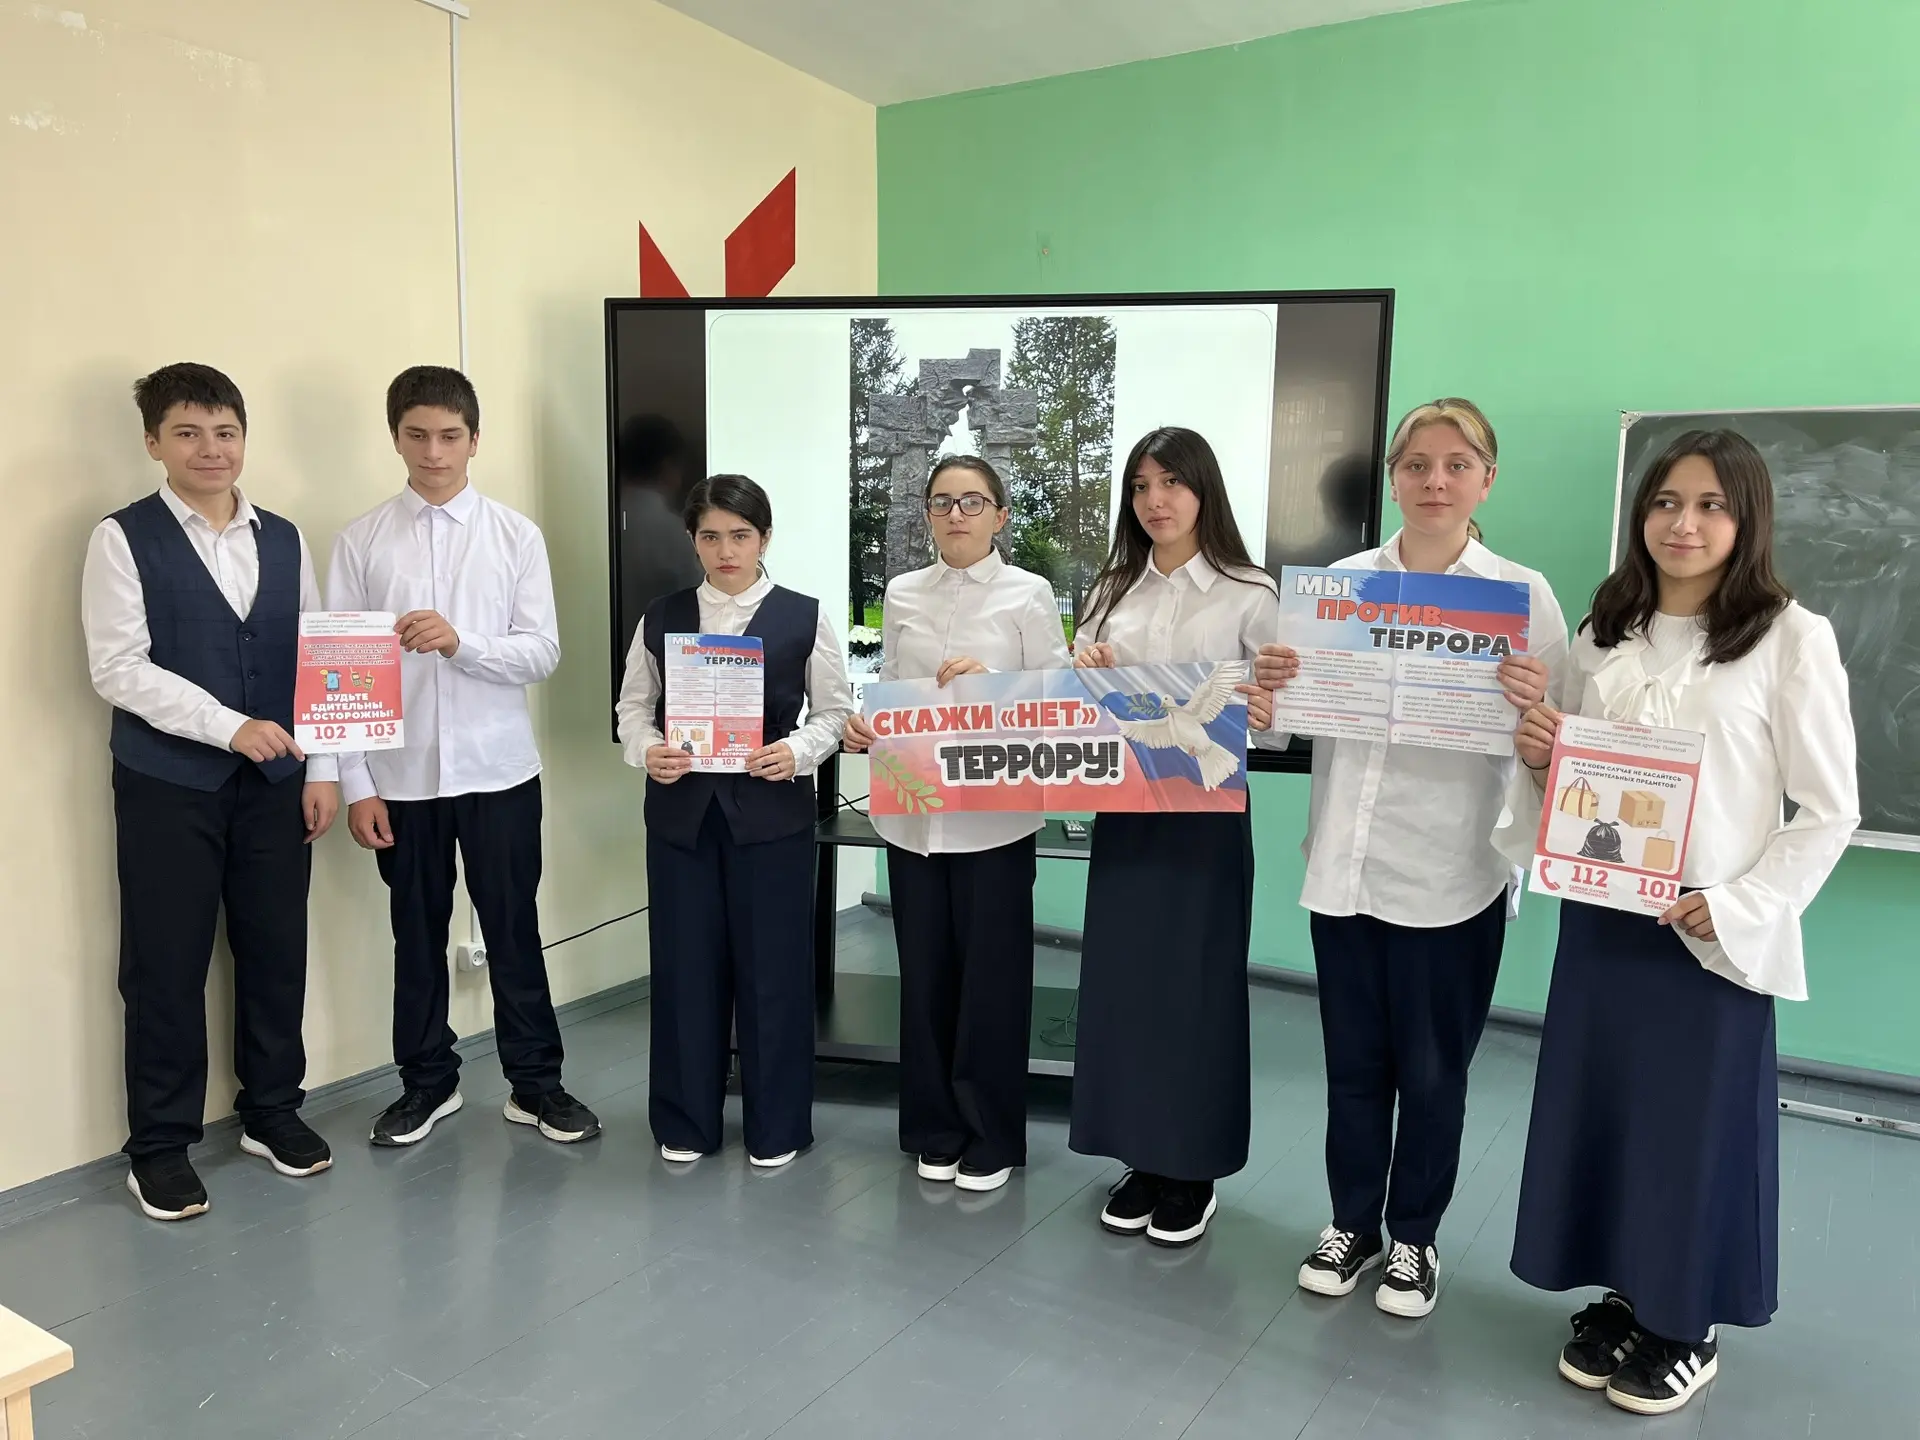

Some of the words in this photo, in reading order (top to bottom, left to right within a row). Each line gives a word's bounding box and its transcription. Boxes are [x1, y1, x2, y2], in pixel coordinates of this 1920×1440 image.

[1296, 574, 1351, 597] МЫ
[1317, 599, 1443, 627] ПРОТИВ
[672, 637, 695, 645] МЫ
[1369, 627, 1513, 657] ТЕРРОРА
[682, 645, 732, 655] ПРОТИВ
[704, 656, 759, 666] ТЕРРОРА
[326, 693, 369, 702] БУДЬТЕ
[310, 701, 383, 712] БДИТЕЛЬНЫ
[301, 713, 310, 721] И
[312, 709, 394, 720] ОСТОРОЖНЫ!
[873, 705, 993, 736] СКАЖИ
[1001, 700, 1098, 728] «НЕТ»
[314, 725, 347, 739] 102
[365, 723, 396, 737] 103
[940, 741, 1119, 782] ТЕРРОРУ!
[1573, 768, 1635, 783] ПОДОЗРИТЕЛЬНЫХ
[1636, 778, 1677, 789] ПРЕДМЕТОВ!
[1606, 766, 1631, 774] СЛУЧАЕ
[1643, 771, 1682, 782] КАСАЙТЕСЬ
[1571, 865, 1609, 888] 112
[1637, 877, 1677, 902] 101
